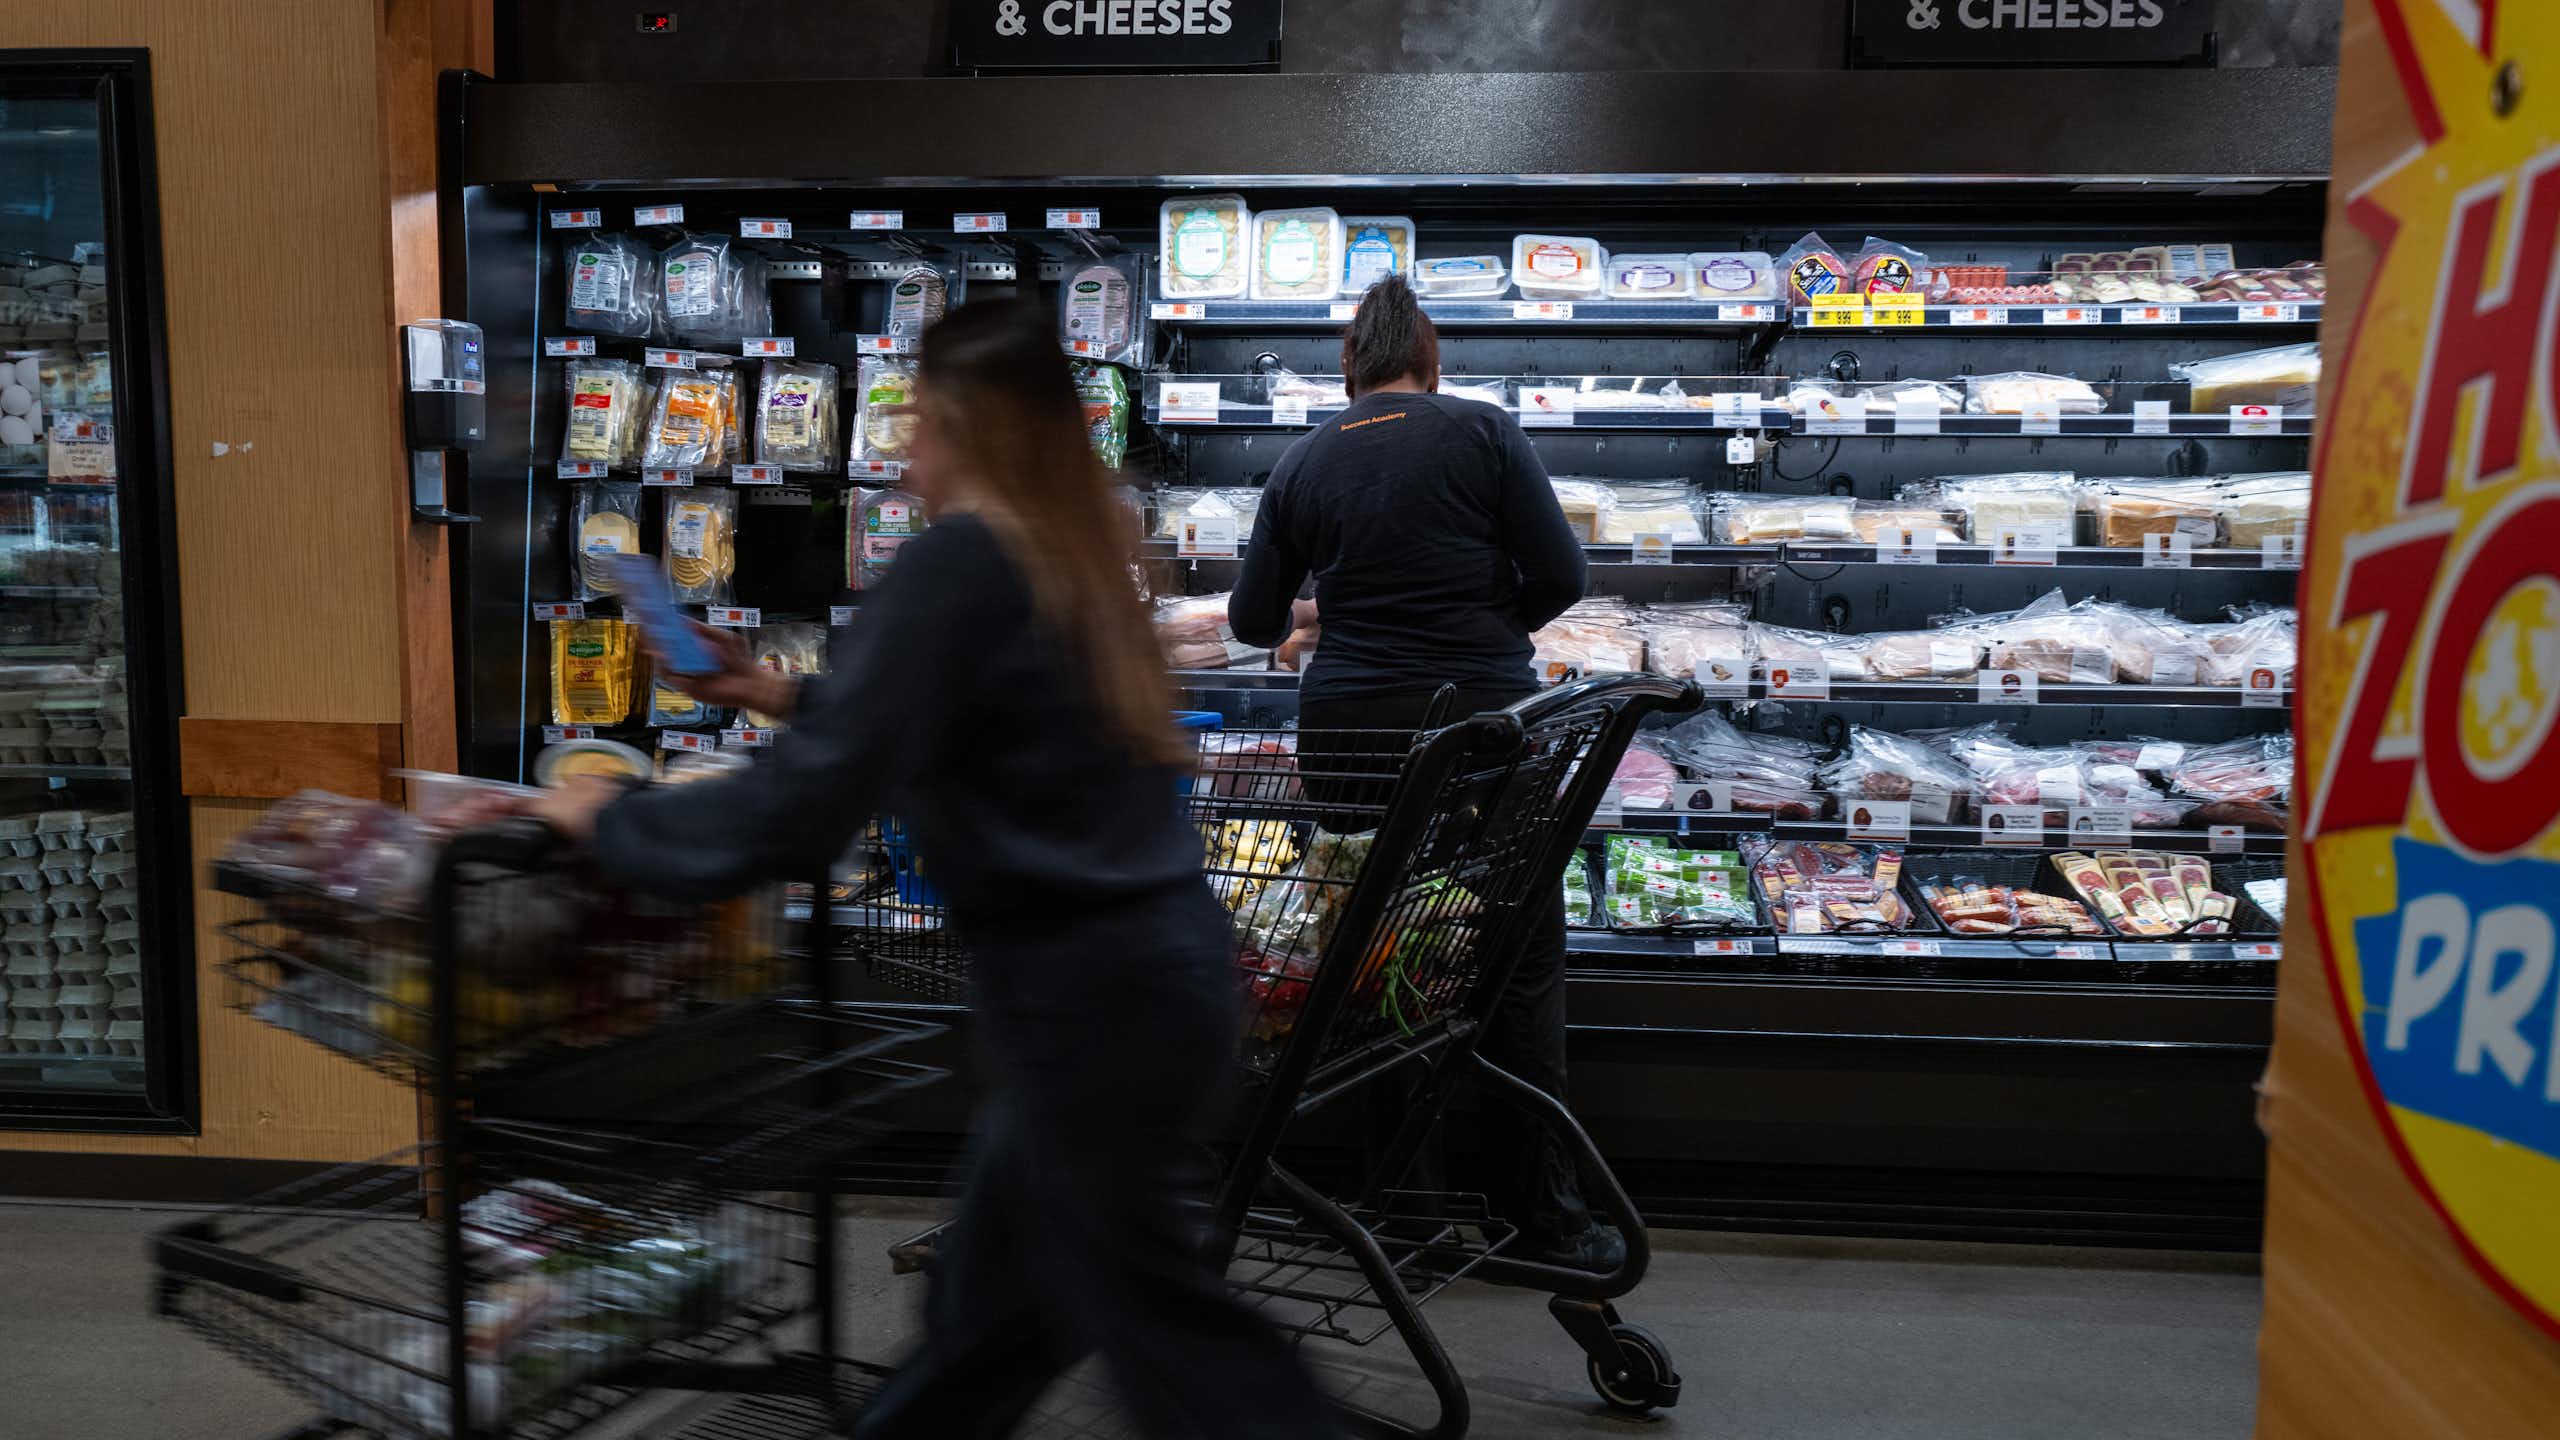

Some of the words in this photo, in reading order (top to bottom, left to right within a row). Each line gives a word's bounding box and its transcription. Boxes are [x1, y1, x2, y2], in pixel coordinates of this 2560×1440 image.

[995, 0, 1027, 37] &
[1042, 0, 1233, 36] CHEESES
[1905, 0, 1941, 30] &
[1957, 0, 2164, 30] CHEESES
[2398, 140, 2560, 515] H
[1371, 411, 1407, 424] Academy
